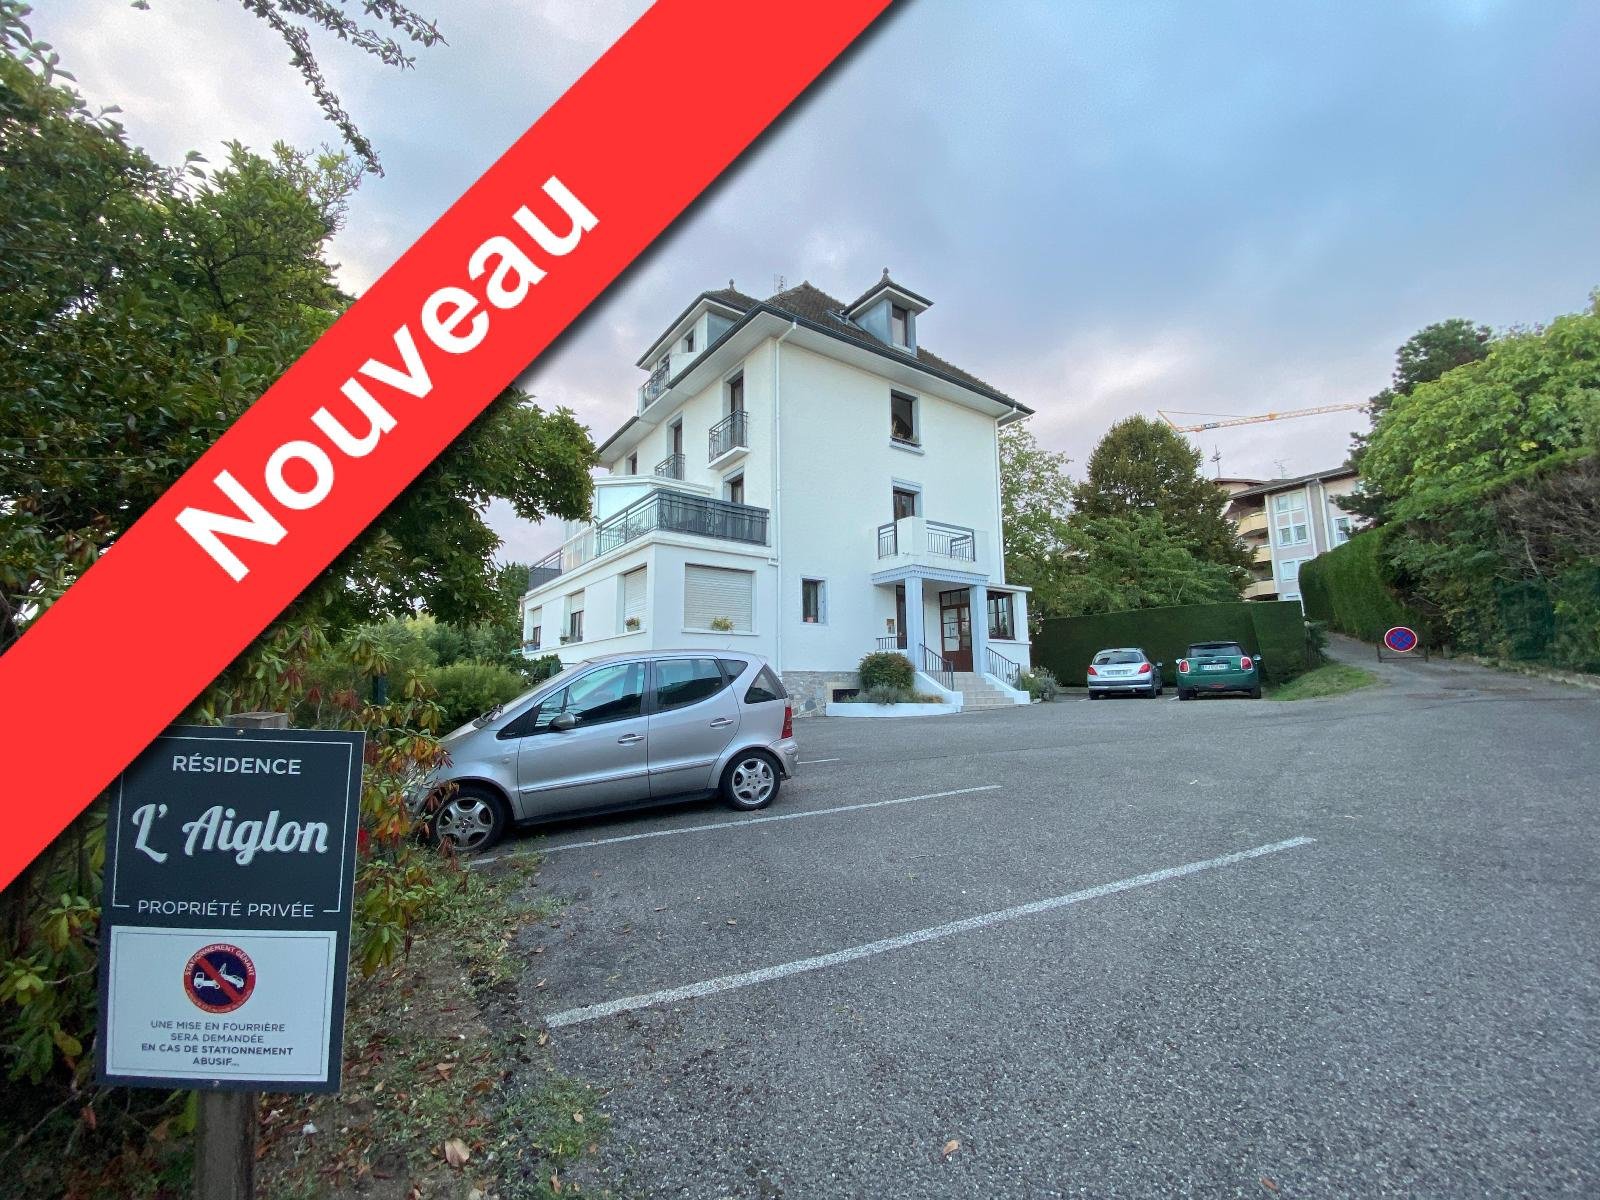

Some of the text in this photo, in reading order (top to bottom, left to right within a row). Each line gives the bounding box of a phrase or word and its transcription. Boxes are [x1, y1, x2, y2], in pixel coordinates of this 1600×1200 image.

[172, 753, 302, 775] RÉSIDENCE
[181, 805, 329, 866] Aiglon
[137, 899, 315, 918] PROPRIÉTÉ PRIVÉE
[150, 1020, 286, 1032] UNE MISE EN FOURRIÈRE
[170, 1032, 264, 1044] SERA DEMANDÉE
[141, 1043, 294, 1056] EN CAS DE STATIONNEMENT
